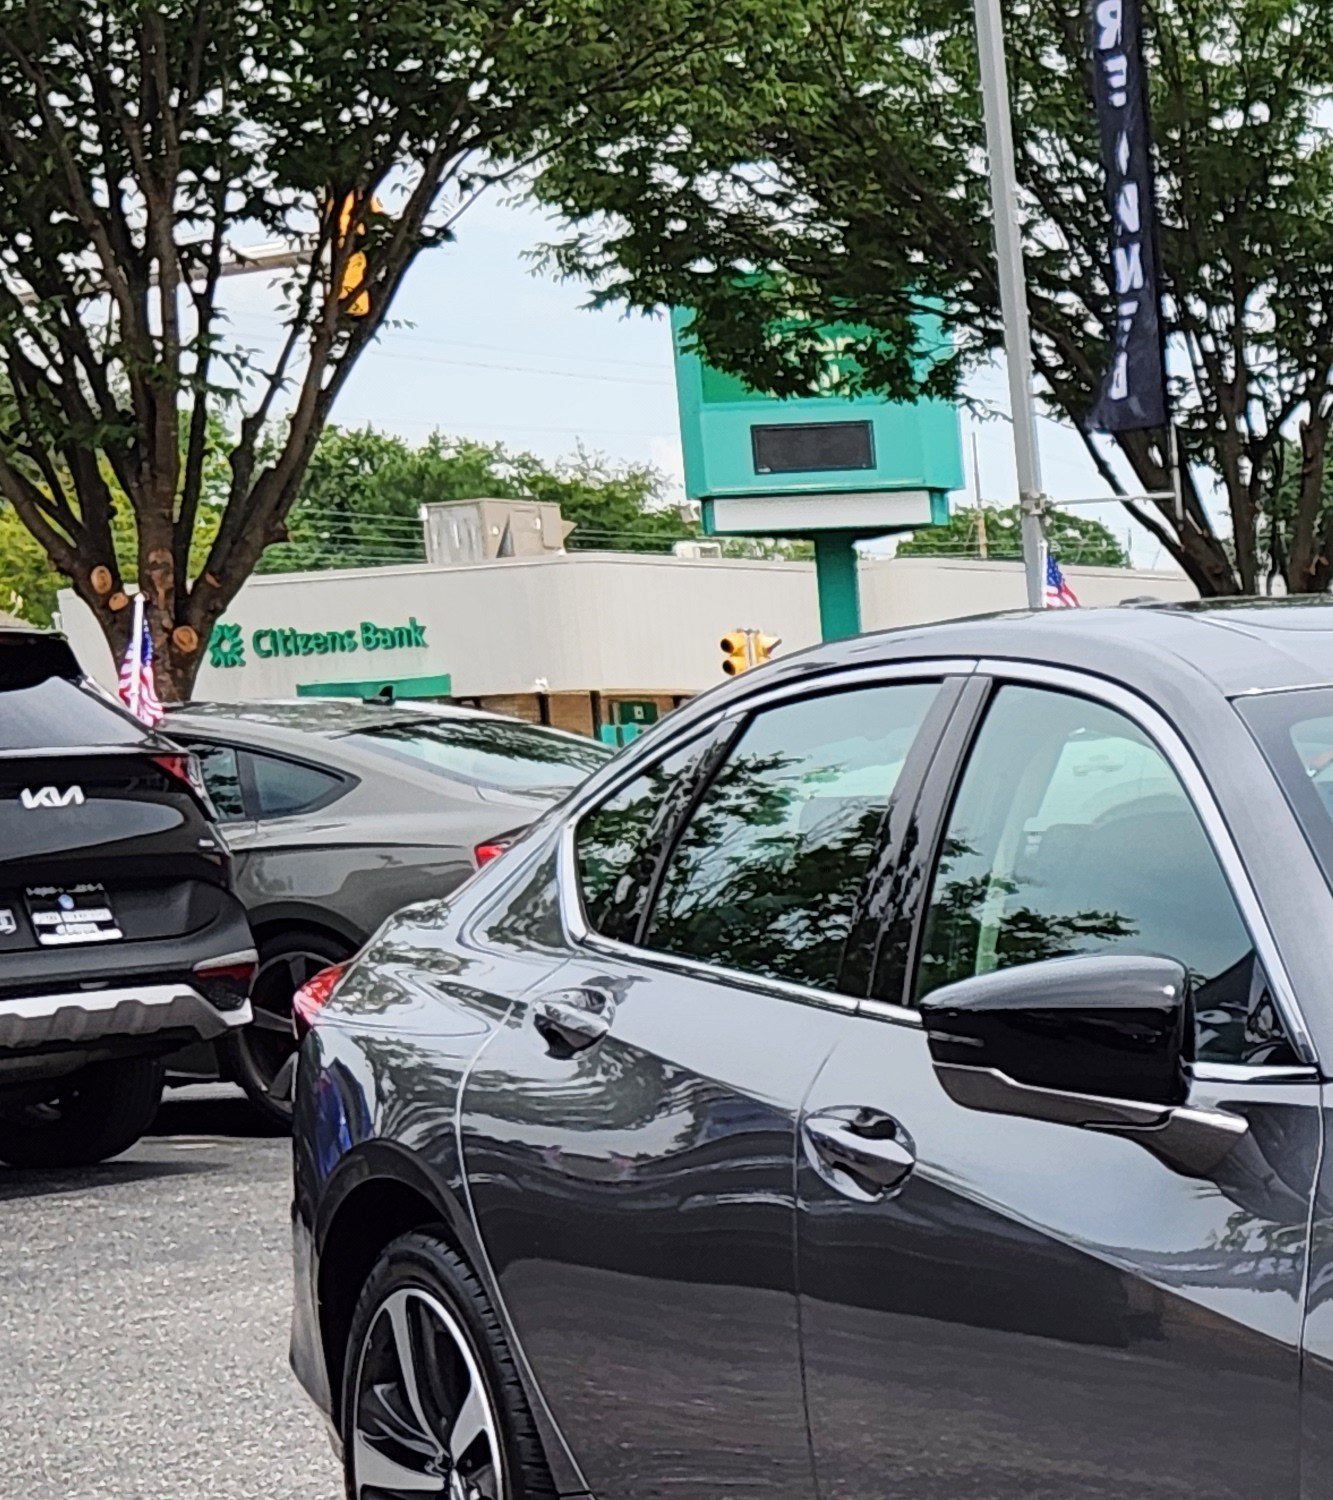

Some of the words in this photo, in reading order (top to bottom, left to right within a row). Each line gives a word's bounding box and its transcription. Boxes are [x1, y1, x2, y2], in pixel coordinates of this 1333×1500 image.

[252, 626, 359, 659] Citizens
[359, 616, 430, 651] Bank
[20, 784, 86, 810] KIA
